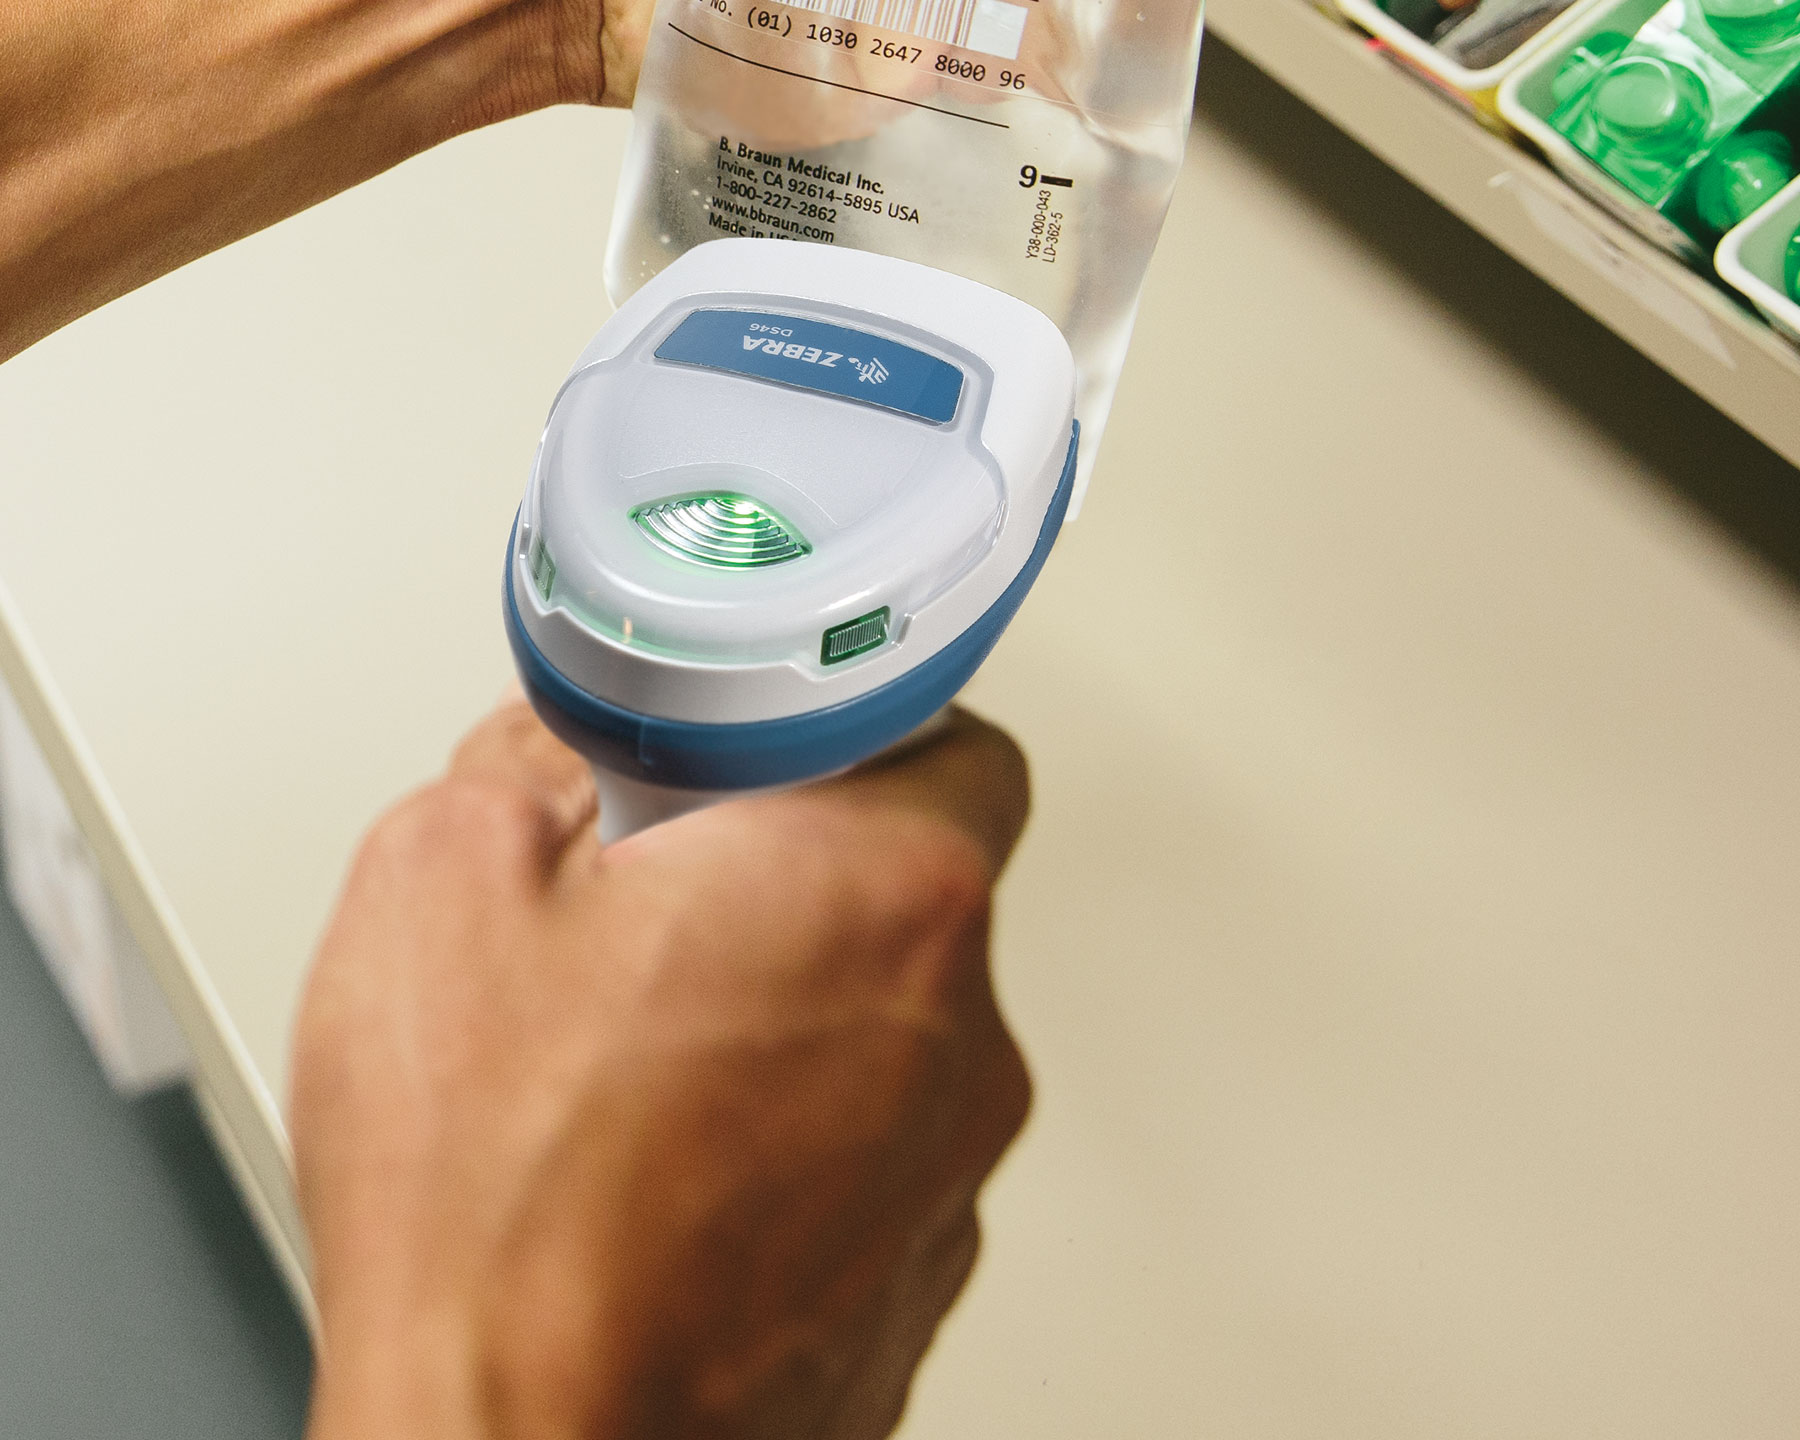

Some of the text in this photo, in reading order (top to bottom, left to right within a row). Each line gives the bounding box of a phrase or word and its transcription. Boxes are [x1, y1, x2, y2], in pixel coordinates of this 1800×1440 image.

[747, 5, 793, 37] (01)
[806, 22, 858, 50] 1030
[870, 38, 923, 64] 2647
[934, 54, 987, 82] 8000
[999, 70, 1027, 91] 96
[716, 154, 921, 225] Irvine, CA 92614-5895 USA
[718, 135, 886, 197] B. Braun Medical Inc.
[1019, 164, 1037, 190] 9
[711, 195, 835, 244] www.bbraun.com
[714, 174, 838, 224] 1-800-227-2862
[708, 212, 747, 237] Made
[1025, 188, 1053, 261] Y38-000-043
[1041, 211, 1065, 264] LD-362-5
[742, 334, 845, 369] ZEBRA
[749, 321, 794, 337] DS46
